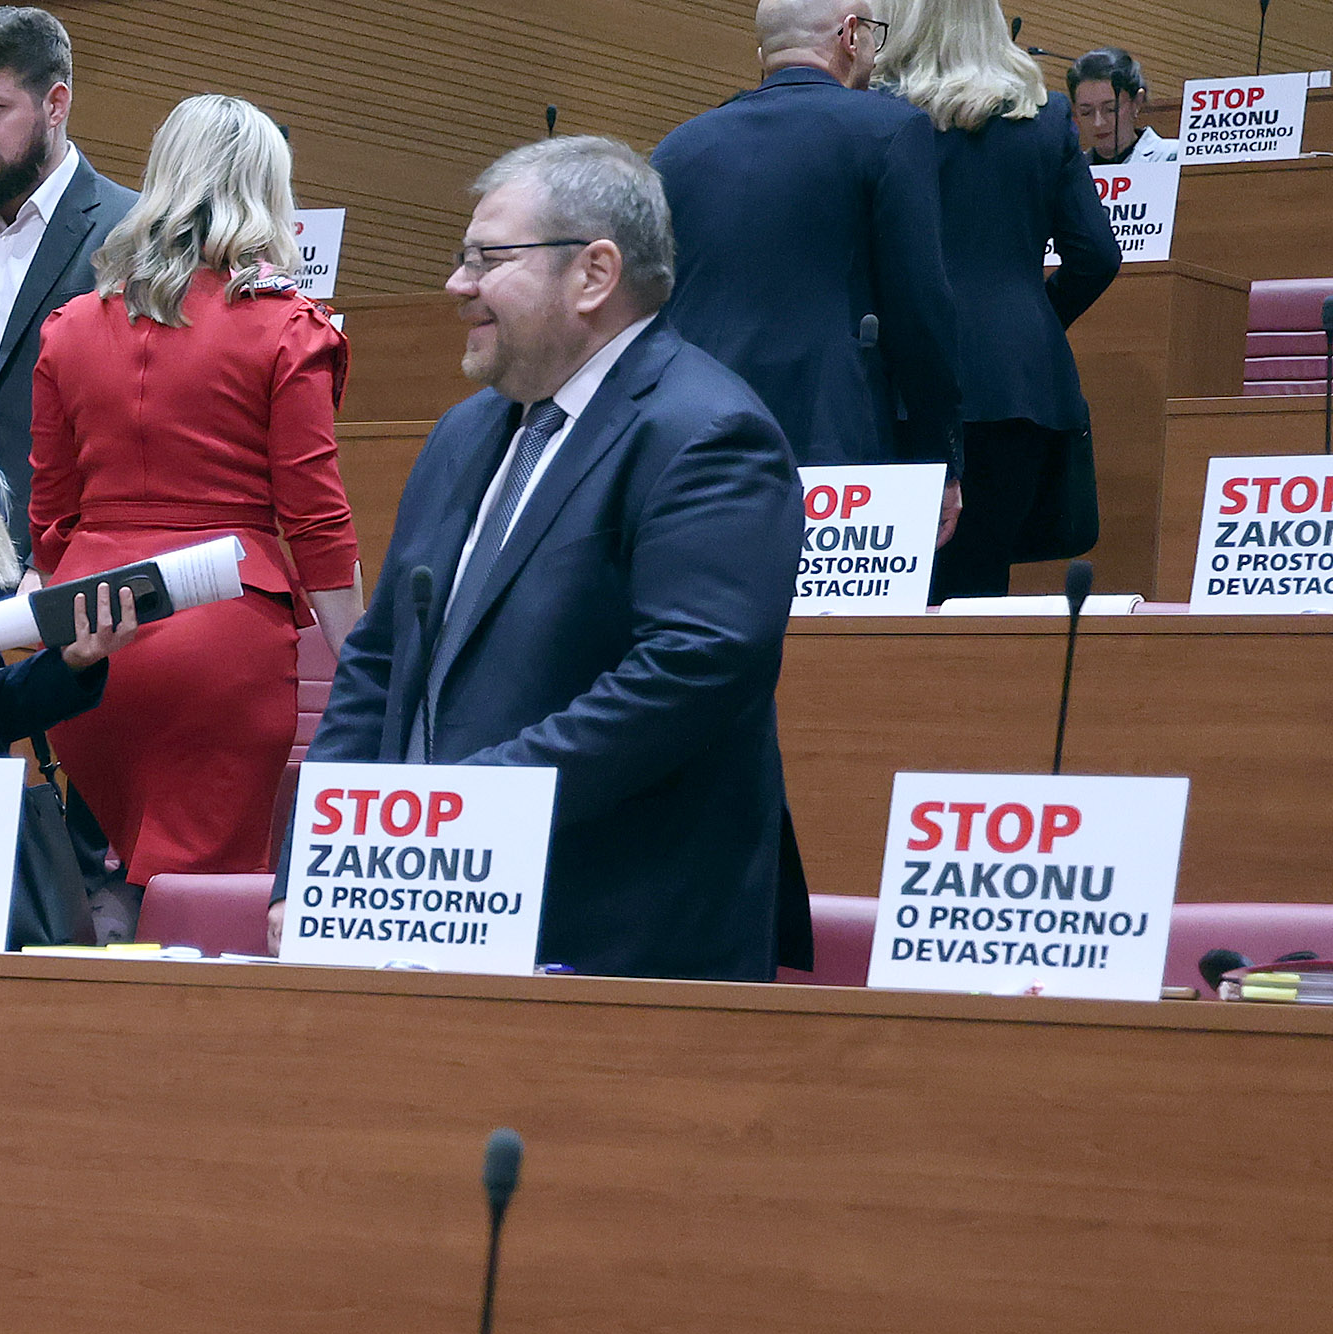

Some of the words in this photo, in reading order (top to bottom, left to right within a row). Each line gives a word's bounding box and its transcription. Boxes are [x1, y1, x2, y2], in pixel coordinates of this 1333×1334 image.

[1191, 88, 1265, 111] STOP
[1189, 110, 1279, 129] ZAKONU
[1187, 132, 1197, 142] O
[1201, 127, 1293, 142] PROSTORNOJ
[1185, 141, 1277, 156] DEVASTACIJI!
[1111, 223, 1163, 236] ORNOJ
[804, 485, 871, 520] OP
[803, 525, 894, 551] KONU
[797, 556, 917, 574] OSTORNOJ
[1211, 554, 1229, 571] O
[1237, 553, 1333, 571] PROSTO
[800, 580, 890, 597] STACIJI!
[1207, 577, 1333, 595] DEVASTAC
[311, 788, 463, 837] STOP
[906, 801, 1082, 854] STOP
[306, 844, 493, 882] ZAKONU
[900, 860, 1115, 902] ZAKONU
[303, 886, 322, 908] O
[331, 886, 522, 915] PROSTORNOJ
[299, 916, 487, 945] DEVASTACIJI!
[897, 905, 918, 928] O
[929, 906, 1149, 937] PROSTORNOJ
[891, 937, 1109, 969] DEVASTACIJI!
